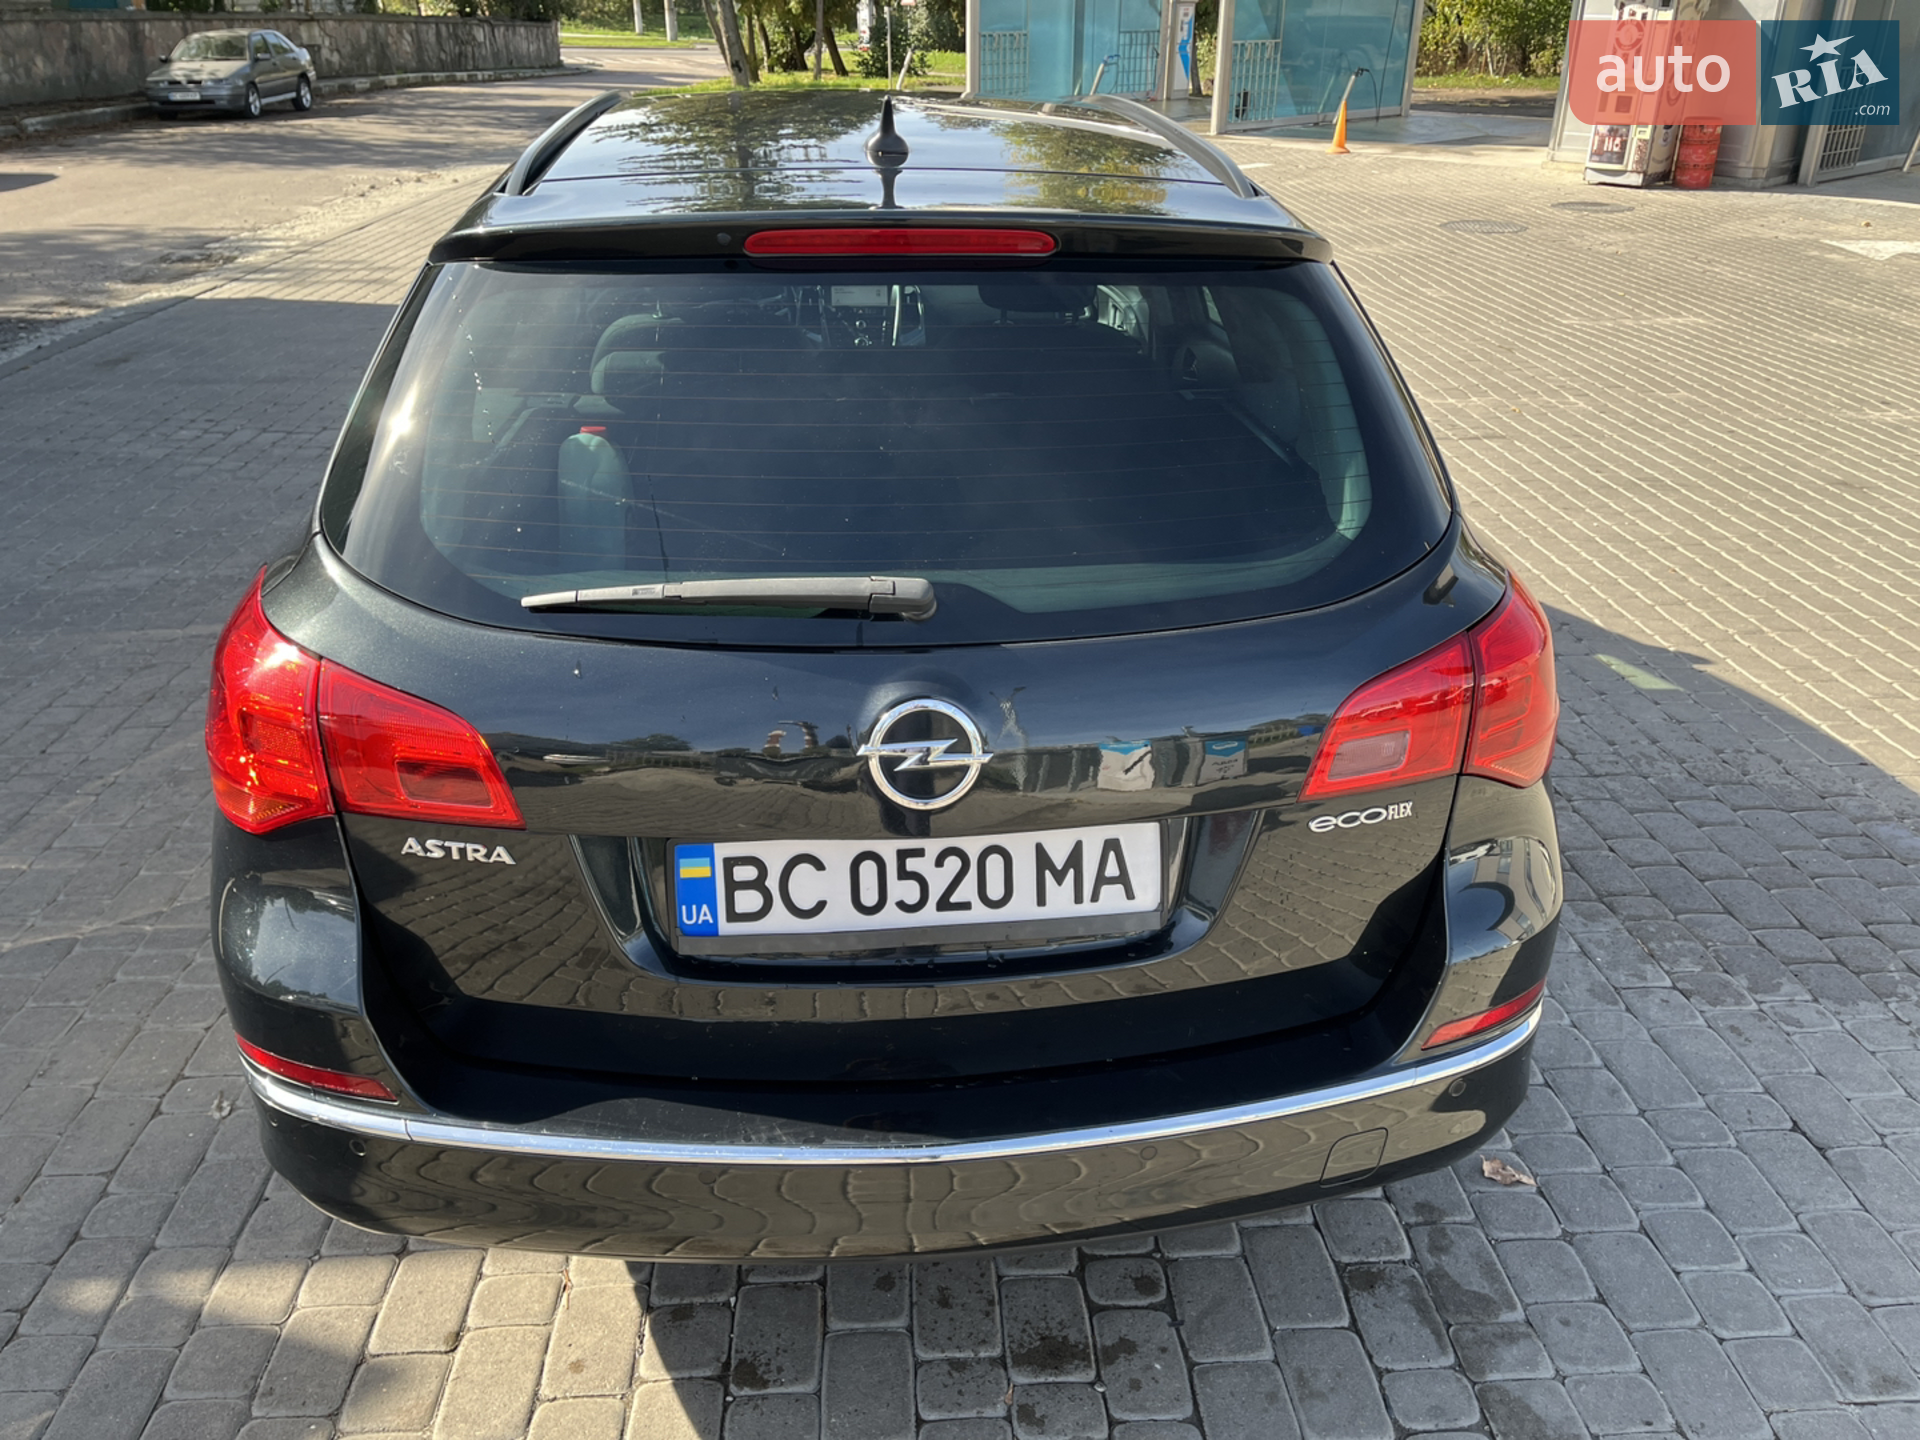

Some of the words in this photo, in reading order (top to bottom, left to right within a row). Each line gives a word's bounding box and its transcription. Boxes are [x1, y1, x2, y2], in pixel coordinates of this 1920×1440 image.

[400, 836, 517, 865] ASTRA
[722, 852, 828, 923] BC
[849, 844, 1014, 917] 0520
[1035, 838, 1136, 908] MA
[681, 904, 714, 926] UA
